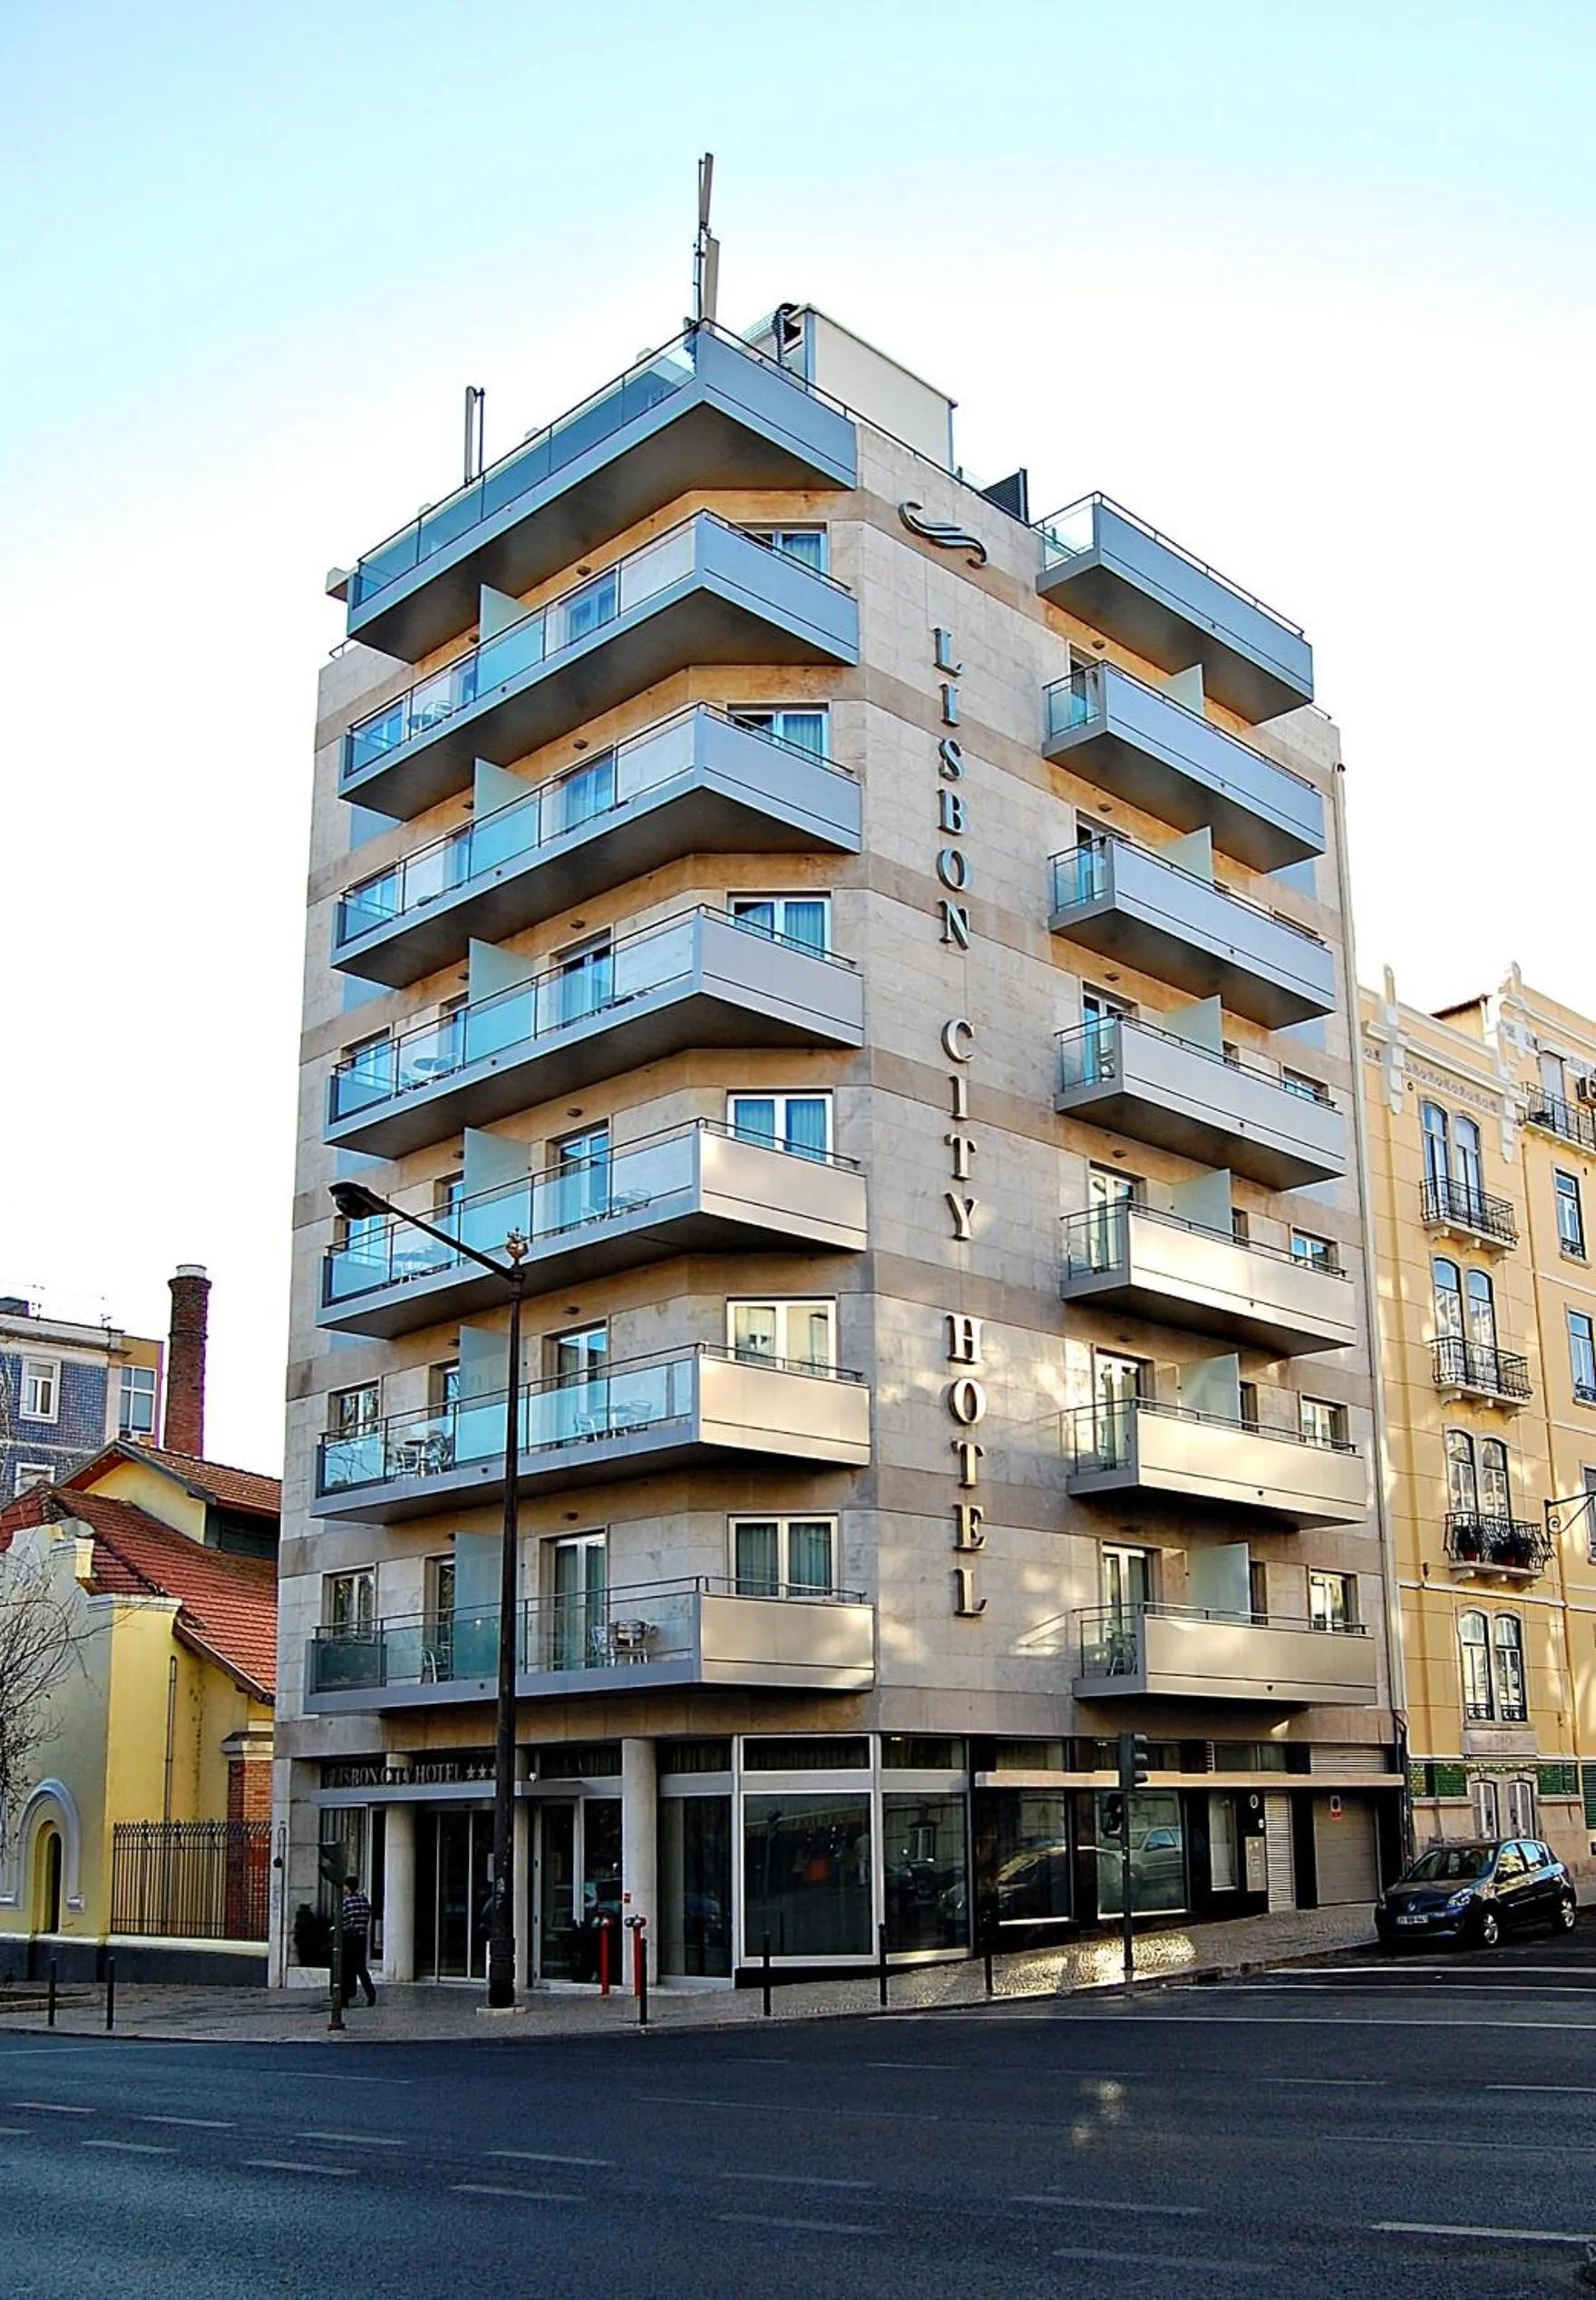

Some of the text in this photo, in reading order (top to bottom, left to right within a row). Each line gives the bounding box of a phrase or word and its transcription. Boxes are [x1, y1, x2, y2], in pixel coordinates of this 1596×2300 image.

[931, 627, 987, 1617] LISBON CITY HOTEL
[415, 1762, 461, 1782] HOTEL
